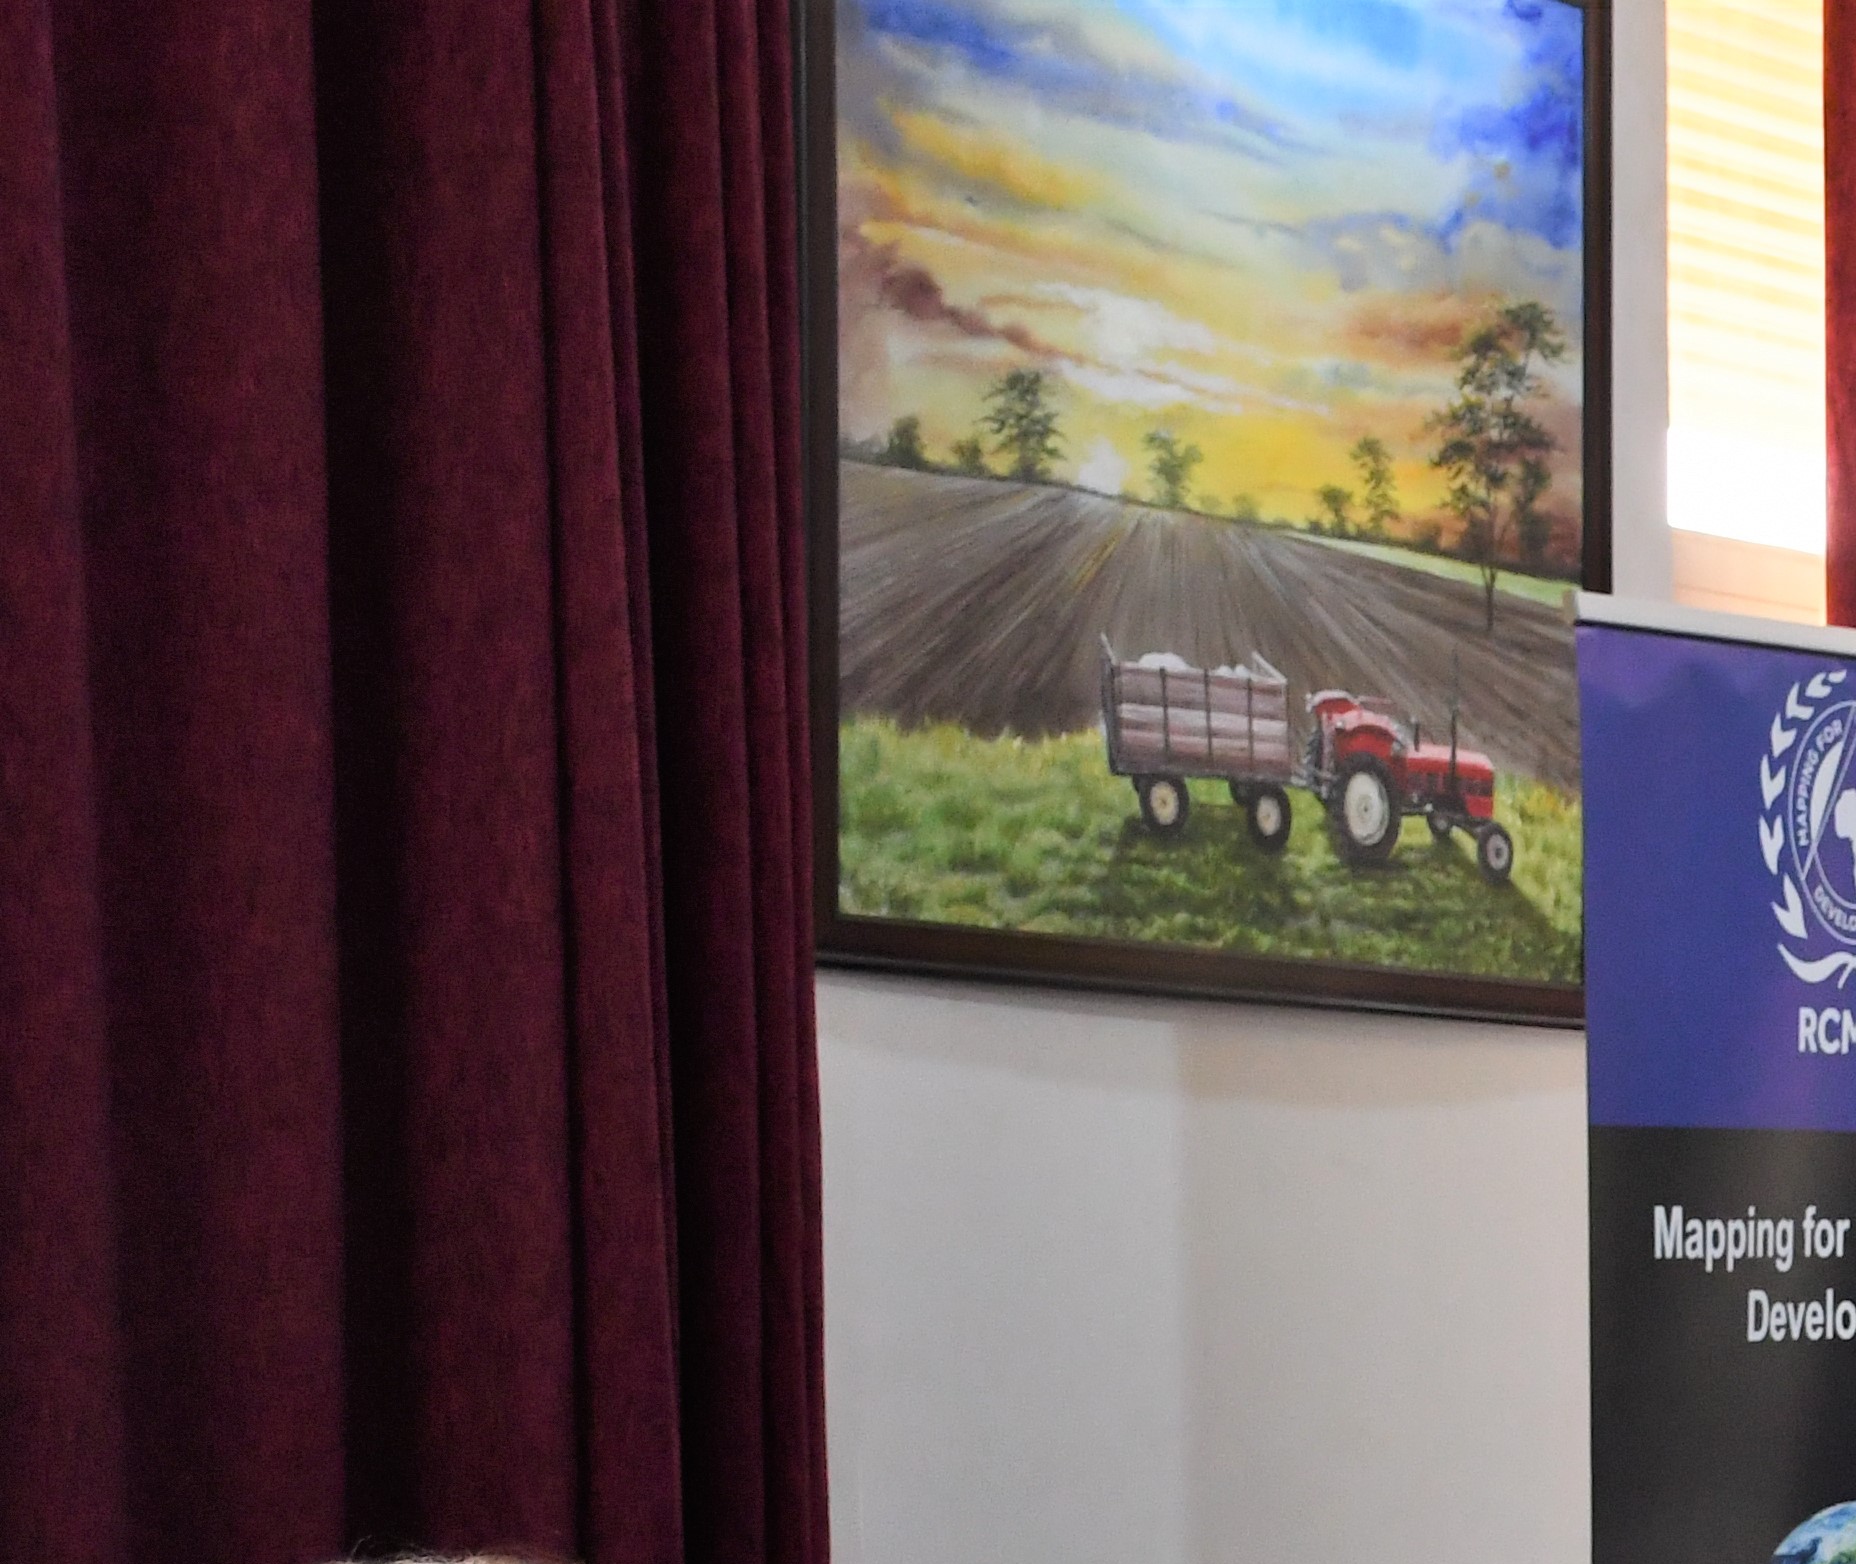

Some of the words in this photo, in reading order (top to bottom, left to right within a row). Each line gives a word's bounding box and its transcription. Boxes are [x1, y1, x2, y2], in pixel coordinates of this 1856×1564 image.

[1796, 748, 1820, 847] MAPPING
[1815, 718, 1843, 751] FOR
[1653, 1204, 1794, 1274] Mapping
[1802, 1204, 1851, 1259] for
